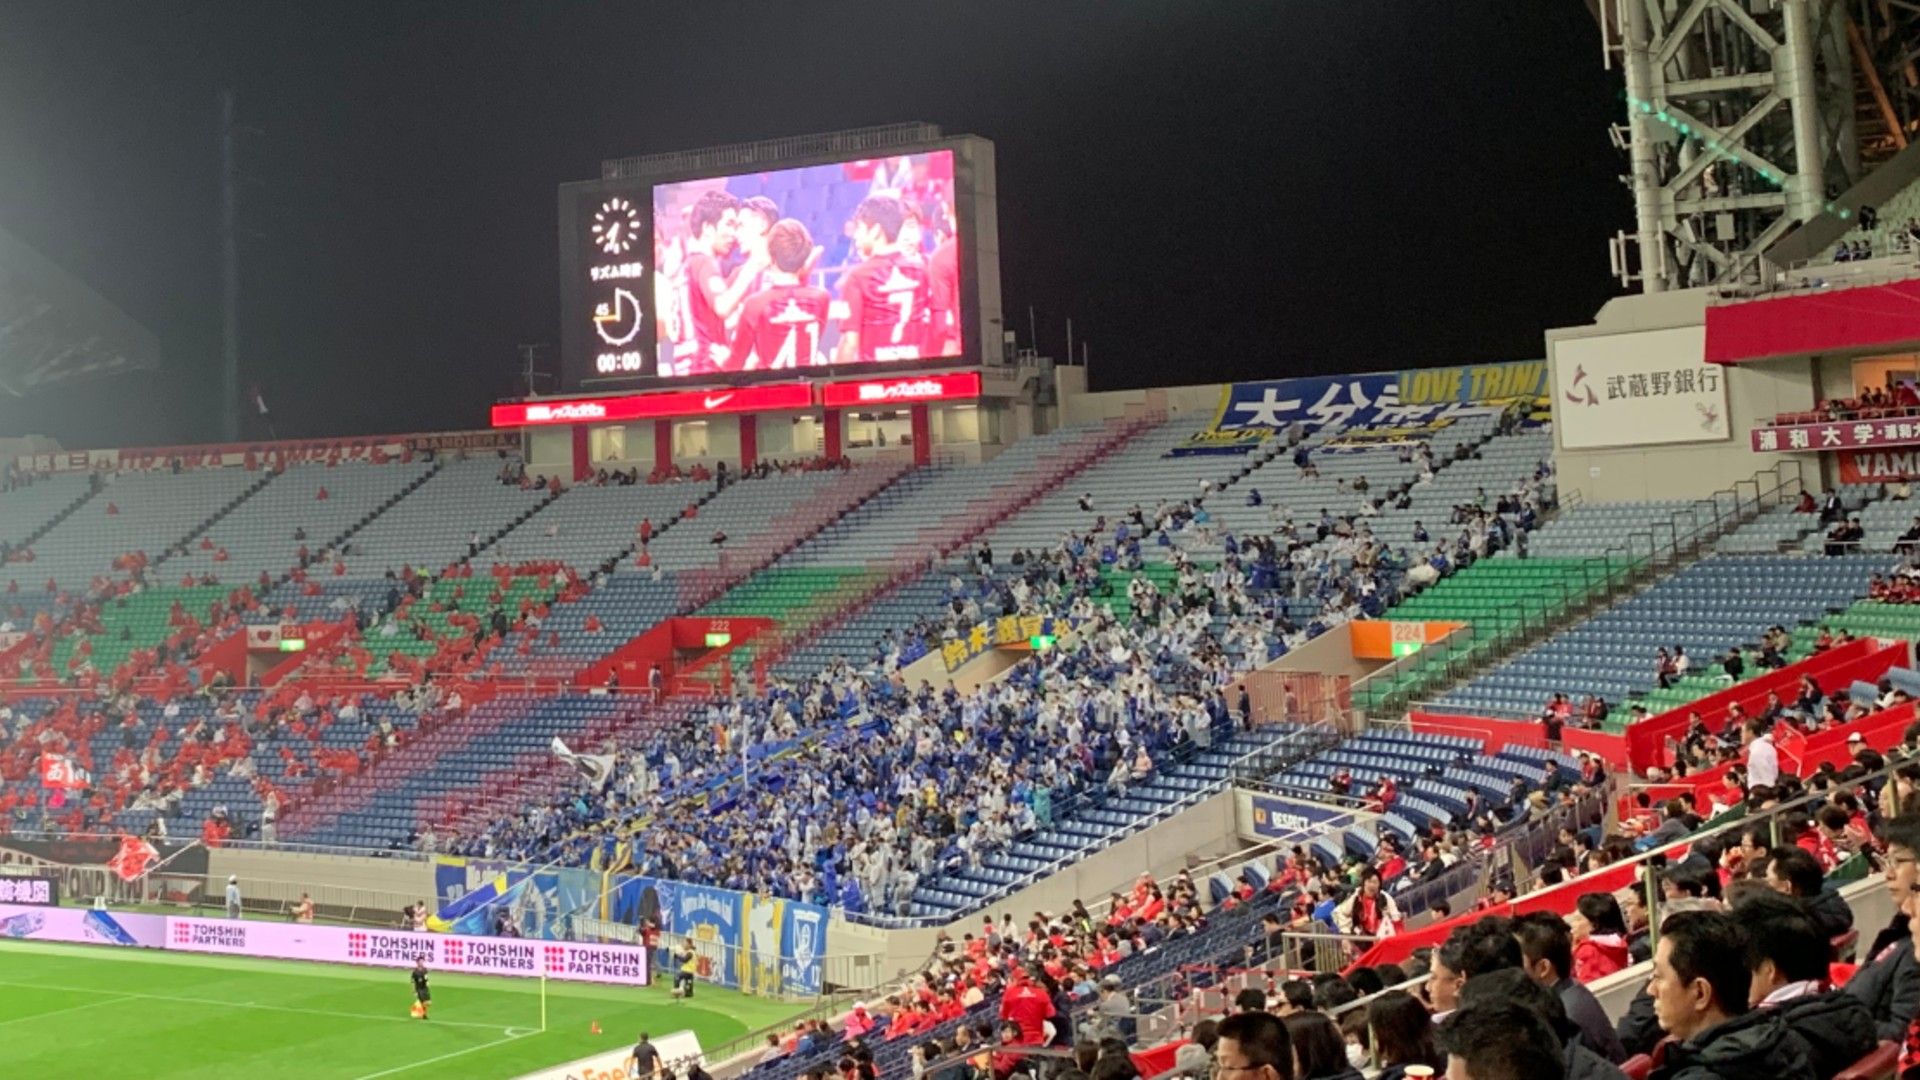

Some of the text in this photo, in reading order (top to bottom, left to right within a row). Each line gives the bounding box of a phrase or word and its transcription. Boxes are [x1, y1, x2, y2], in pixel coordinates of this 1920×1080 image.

[1400, 361, 1550, 404] LOVE TRINI
[1606, 366, 1719, 400] 武蔵野銀行
[1854, 451, 1920, 477] VAM
[710, 620, 730, 631] 222
[1395, 624, 1421, 641] 224
[192, 923, 245, 938] TOHSHIN
[192, 935, 245, 948] PARTNERS
[370, 935, 435, 951] TOHSHIN
[467, 941, 535, 958] TOHSHIN
[370, 947, 435, 963] PARTNERS
[467, 954, 535, 970] PARTNERS
[569, 949, 640, 965] TOHSHIN
[568, 962, 640, 977] PARTNERS
